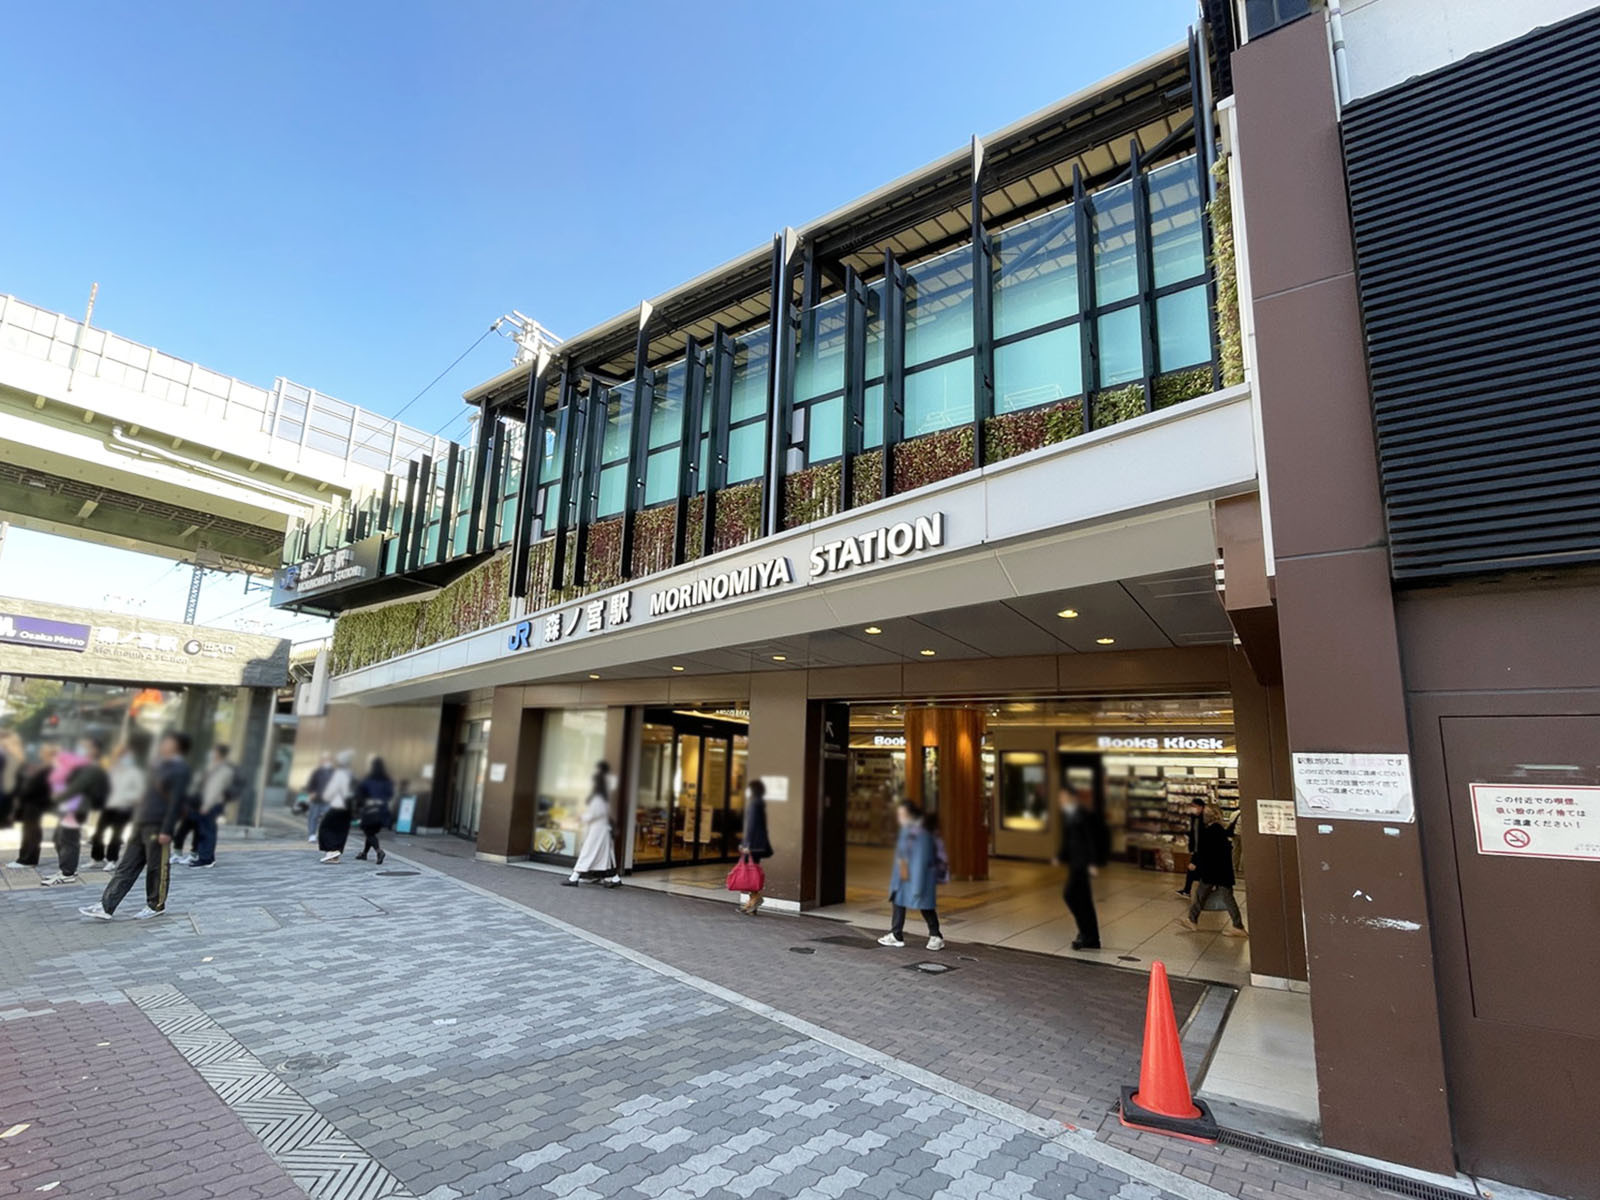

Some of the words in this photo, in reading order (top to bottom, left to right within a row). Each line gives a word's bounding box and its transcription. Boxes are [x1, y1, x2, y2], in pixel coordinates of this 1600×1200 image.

[507, 620, 531, 650] JR
[544, 590, 632, 642] 森ノ宮駅
[650, 556, 794, 616] MORINOMIYA
[809, 512, 945, 577] STATION
[20, 630, 53, 642] Osaka
[53, 635, 85, 646] Metro
[874, 735, 906, 745] Book
[1098, 736, 1158, 748] Books
[1163, 736, 1223, 749] Kiosk
